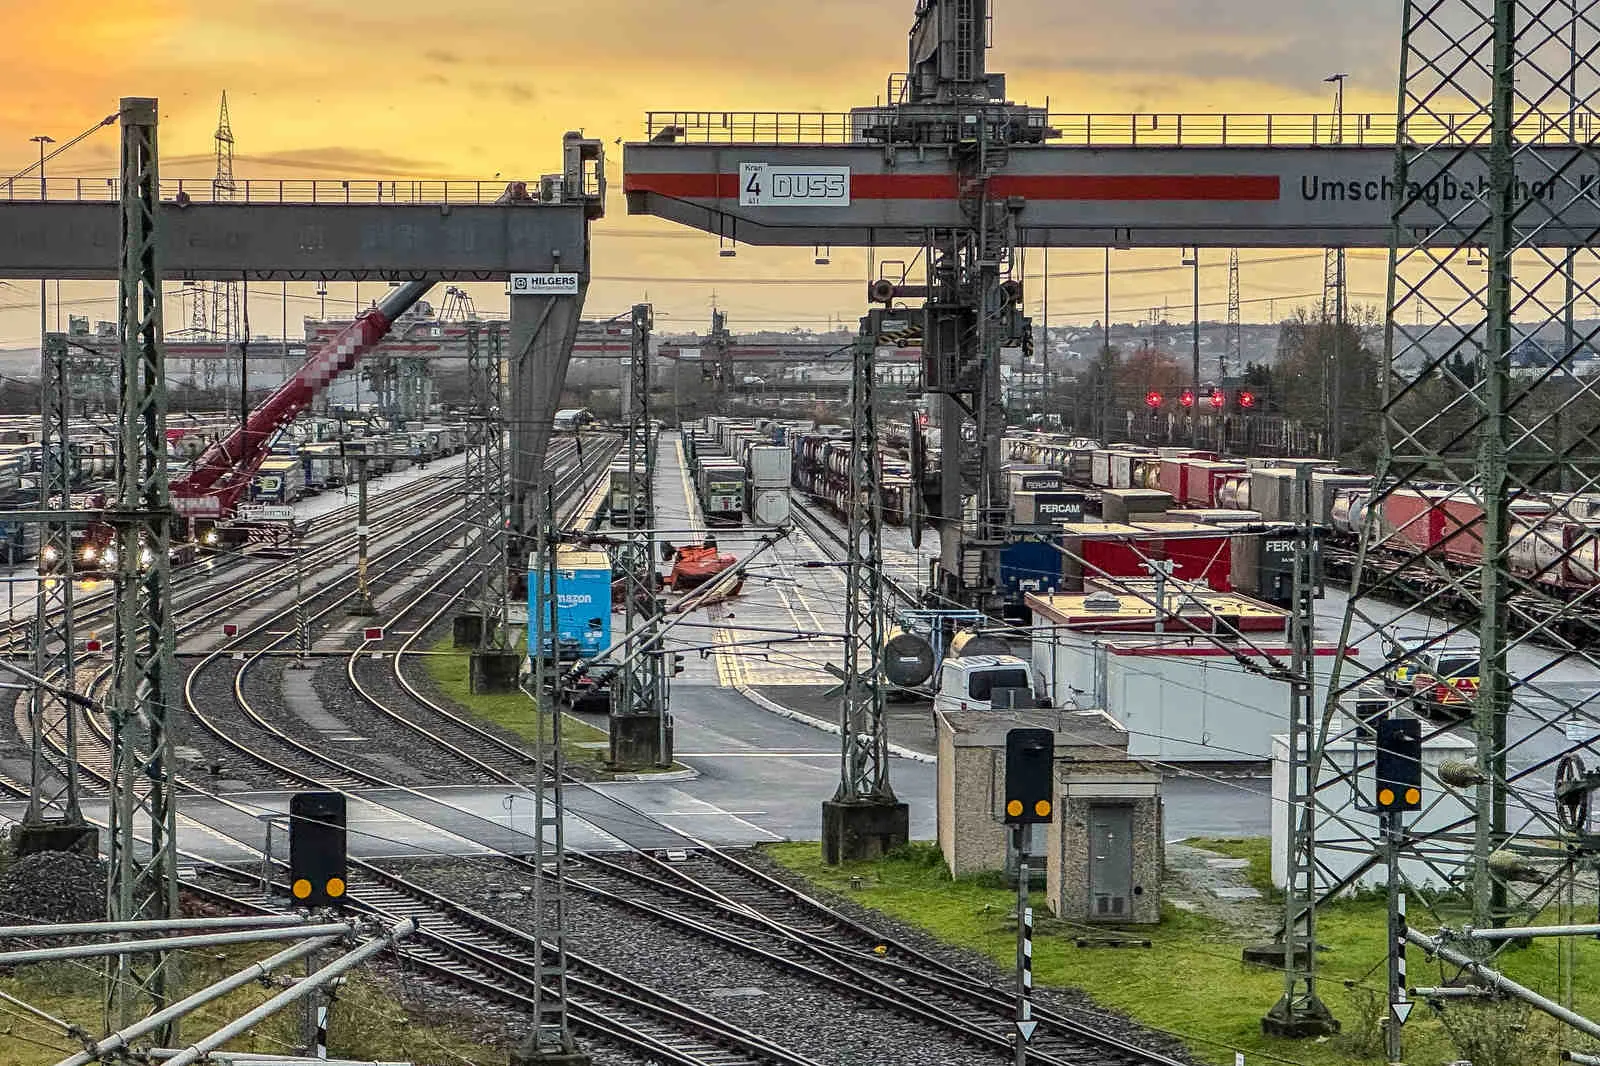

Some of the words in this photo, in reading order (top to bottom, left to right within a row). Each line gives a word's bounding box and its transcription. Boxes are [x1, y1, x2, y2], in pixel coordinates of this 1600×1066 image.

[746, 172, 761, 196] 4
[772, 174, 845, 198] DUSS
[531, 277, 576, 285] HILGERS
[1039, 503, 1081, 513] FERCAM
